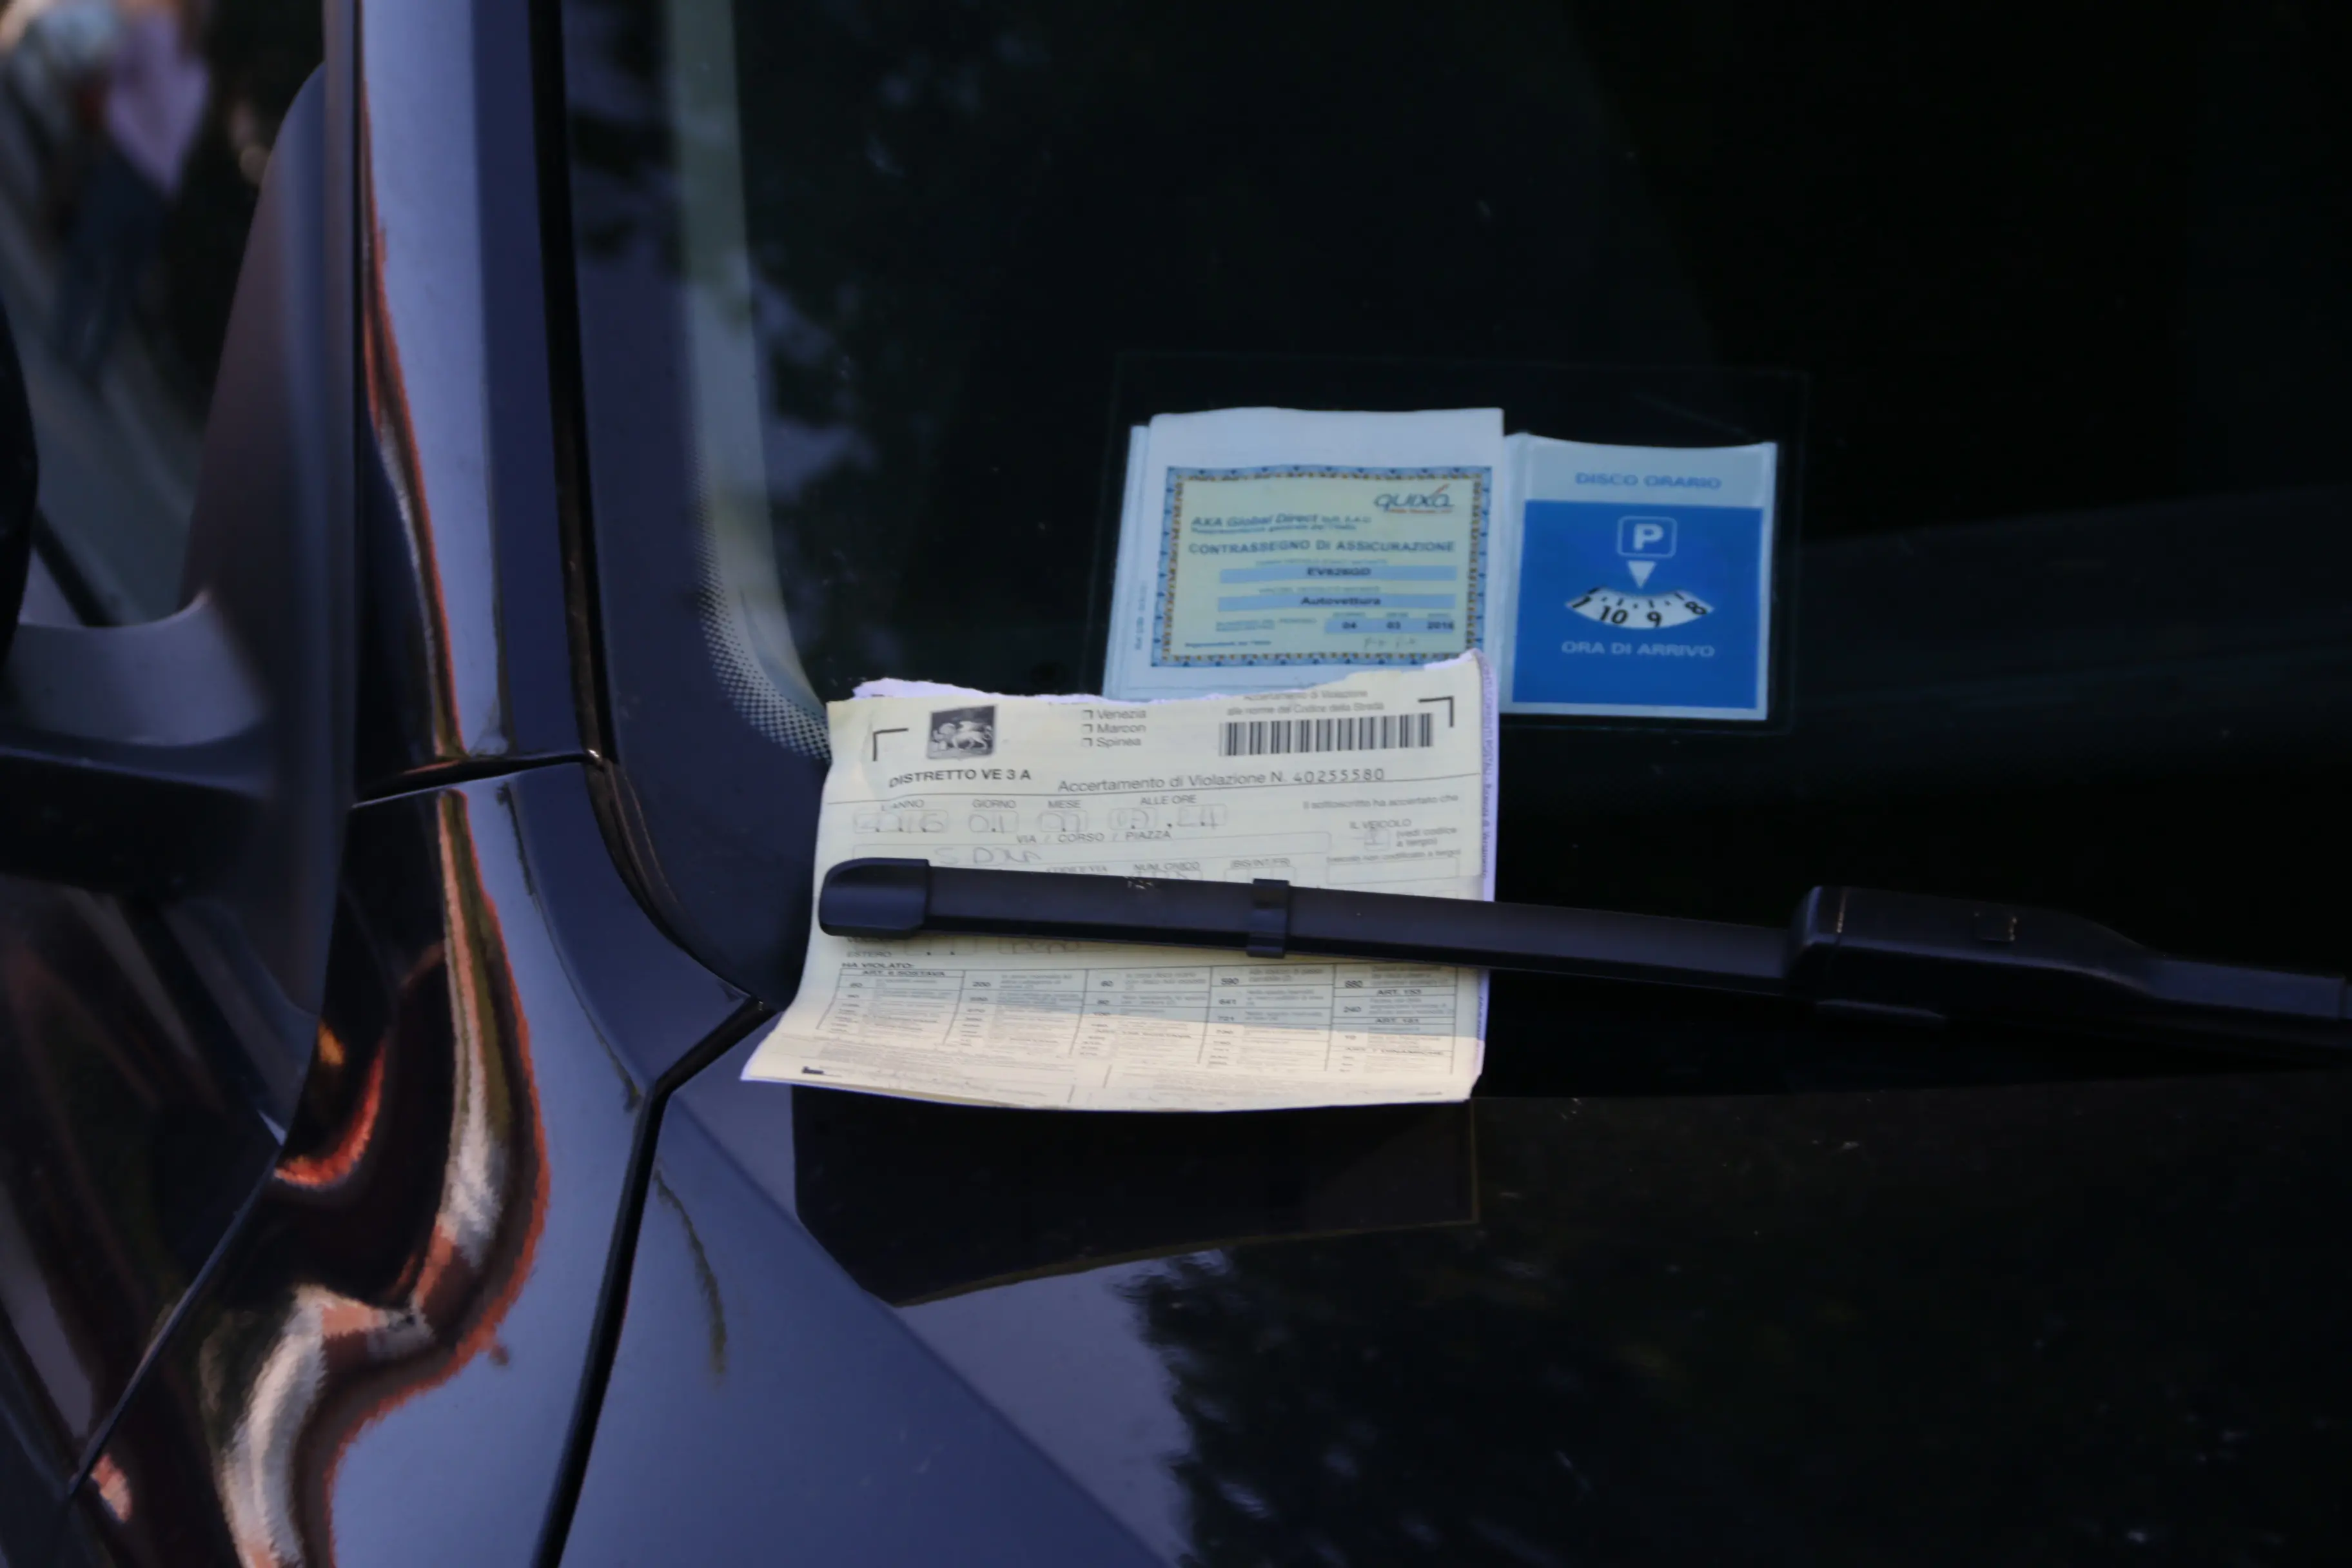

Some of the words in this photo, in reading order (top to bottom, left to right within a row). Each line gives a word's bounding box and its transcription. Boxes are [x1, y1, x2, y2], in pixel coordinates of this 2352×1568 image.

[1576, 472, 1638, 486] DISCO
[1643, 475, 1721, 490] ORARIO
[1191, 516, 1222, 527] AXA
[1227, 514, 1271, 527] Global
[1275, 513, 1318, 524] Direct
[1633, 524, 1663, 551] P
[1188, 540, 1311, 556] CONTRASSEGNO
[1316, 540, 1331, 551] DI
[1336, 540, 1455, 554] ASSICURAZIONE
[1301, 596, 1381, 606] Autovettura
[1599, 606, 1629, 625] 10
[1647, 611, 1662, 627] 9
[1562, 641, 1604, 654] ORA
[1611, 642, 1631, 655] DI
[1637, 643, 1715, 657] ARRIVO
[1096, 709, 1146, 720] Venezia
[1096, 723, 1146, 733] Marcon
[1096, 737, 1142, 748] Spinea
[888, 769, 977, 788] DISTRETTO
[981, 769, 1002, 780] VE
[1006, 769, 1015, 780] 3
[1020, 769, 1032, 780] A
[1057, 777, 1165, 792] Accertamento
[1170, 776, 1183, 789] di
[1188, 772, 1266, 787] Violazione
[1293, 768, 1384, 783] 40255580
[972, 799, 1017, 808] GIORNO
[1048, 799, 1081, 808] MESE
[1141, 797, 1168, 805] ALLE
[1171, 795, 1197, 803] ORE
[1362, 818, 1412, 828] VEICOLO
[1058, 832, 1105, 842] CORSO
[1126, 830, 1171, 839] PIAZZA
